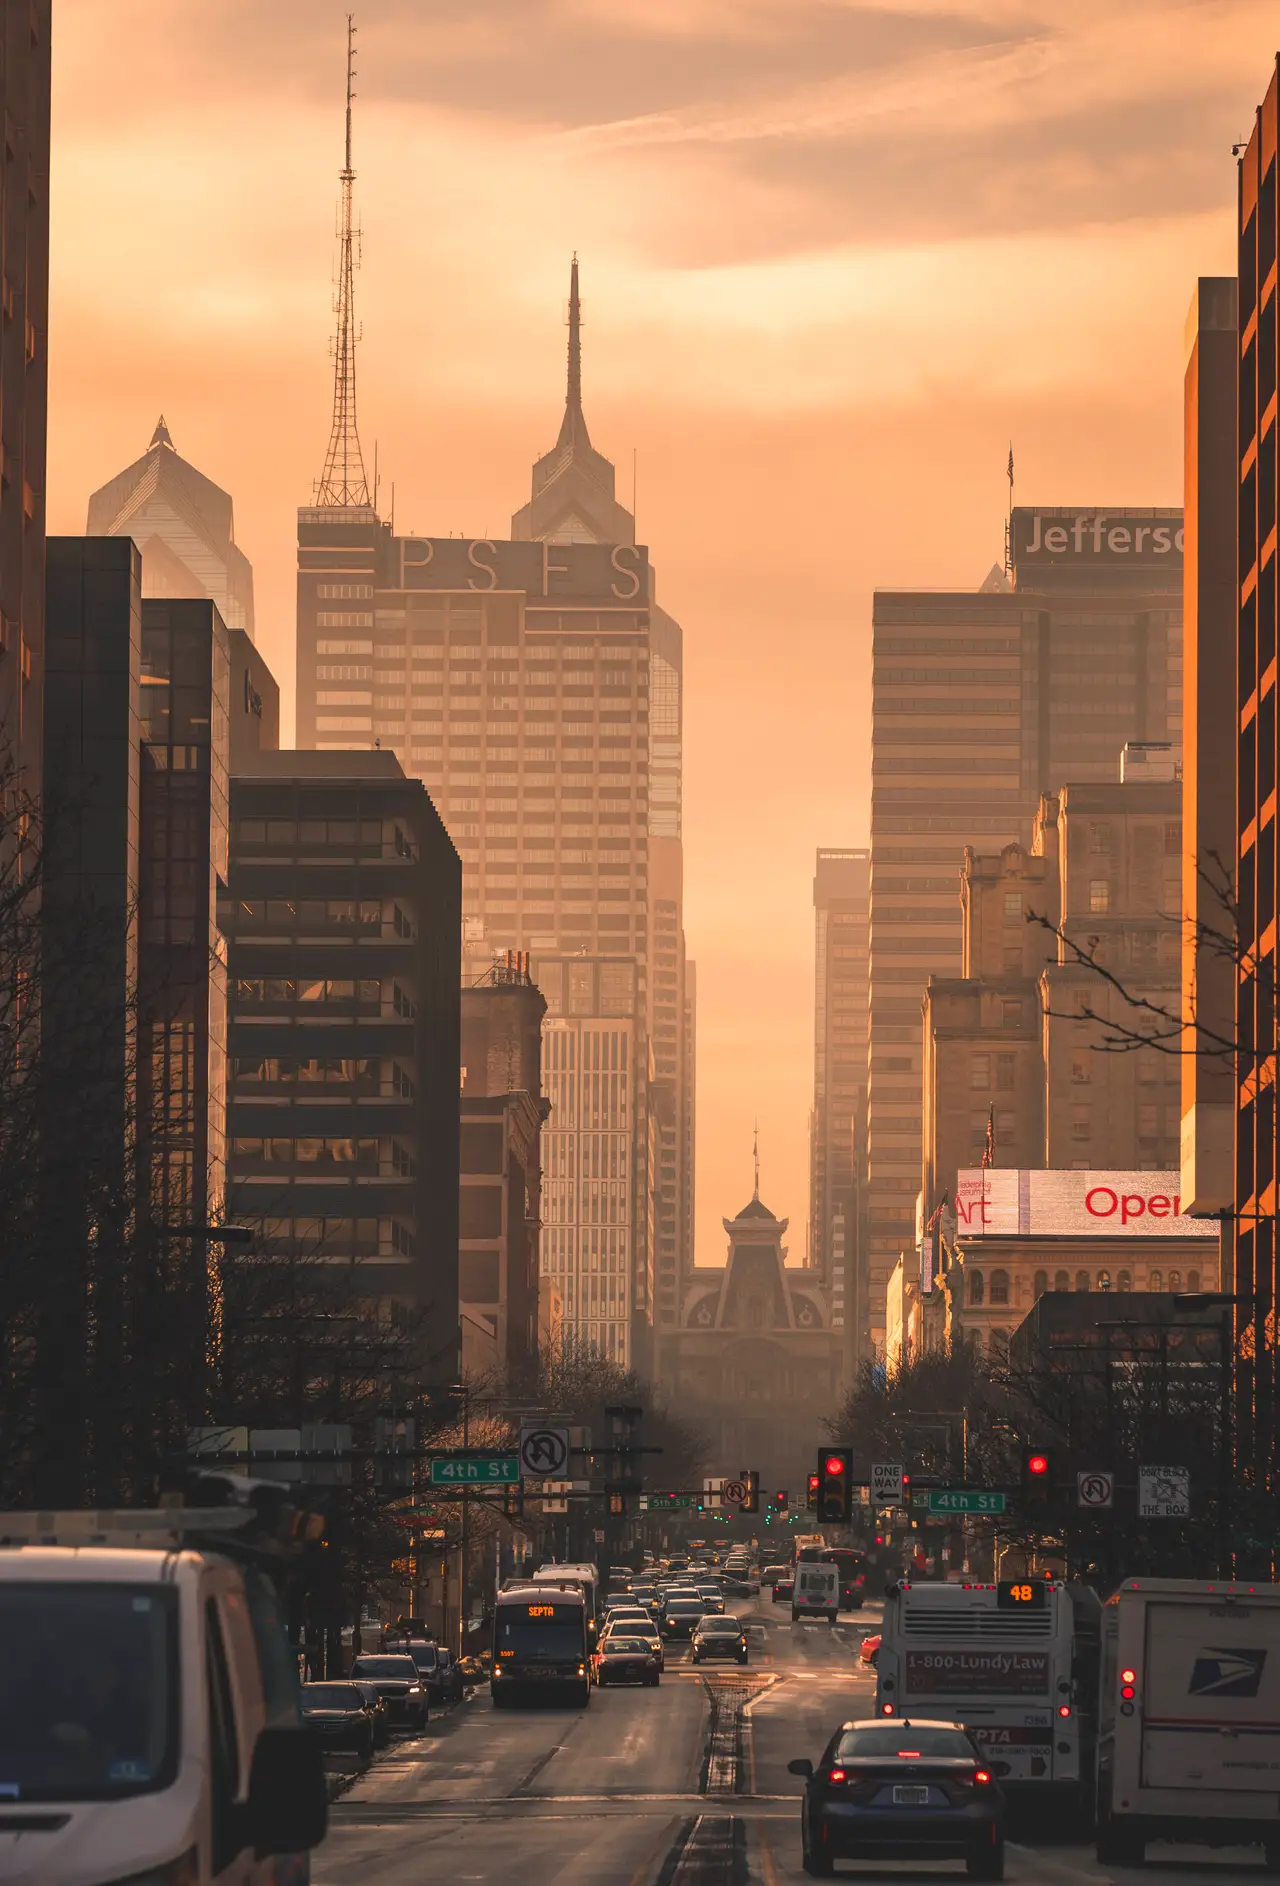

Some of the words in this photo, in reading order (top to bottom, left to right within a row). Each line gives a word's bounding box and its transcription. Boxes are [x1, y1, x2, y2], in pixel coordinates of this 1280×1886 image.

[954, 1194, 992, 1224] Art
[441, 1463, 478, 1477] 4th
[488, 1462, 509, 1477] St
[874, 1466, 900, 1477] ONE
[874, 1478, 900, 1488] WAY
[938, 1494, 969, 1508] 4th
[978, 1495, 996, 1509] St
[1142, 1505, 1161, 1515] THE
[1166, 1505, 1187, 1515] BOX
[1010, 1584, 1033, 1601] 48
[528, 1606, 555, 1617] SEPTA
[908, 1654, 1046, 1673] 1-800-LundyLaw
